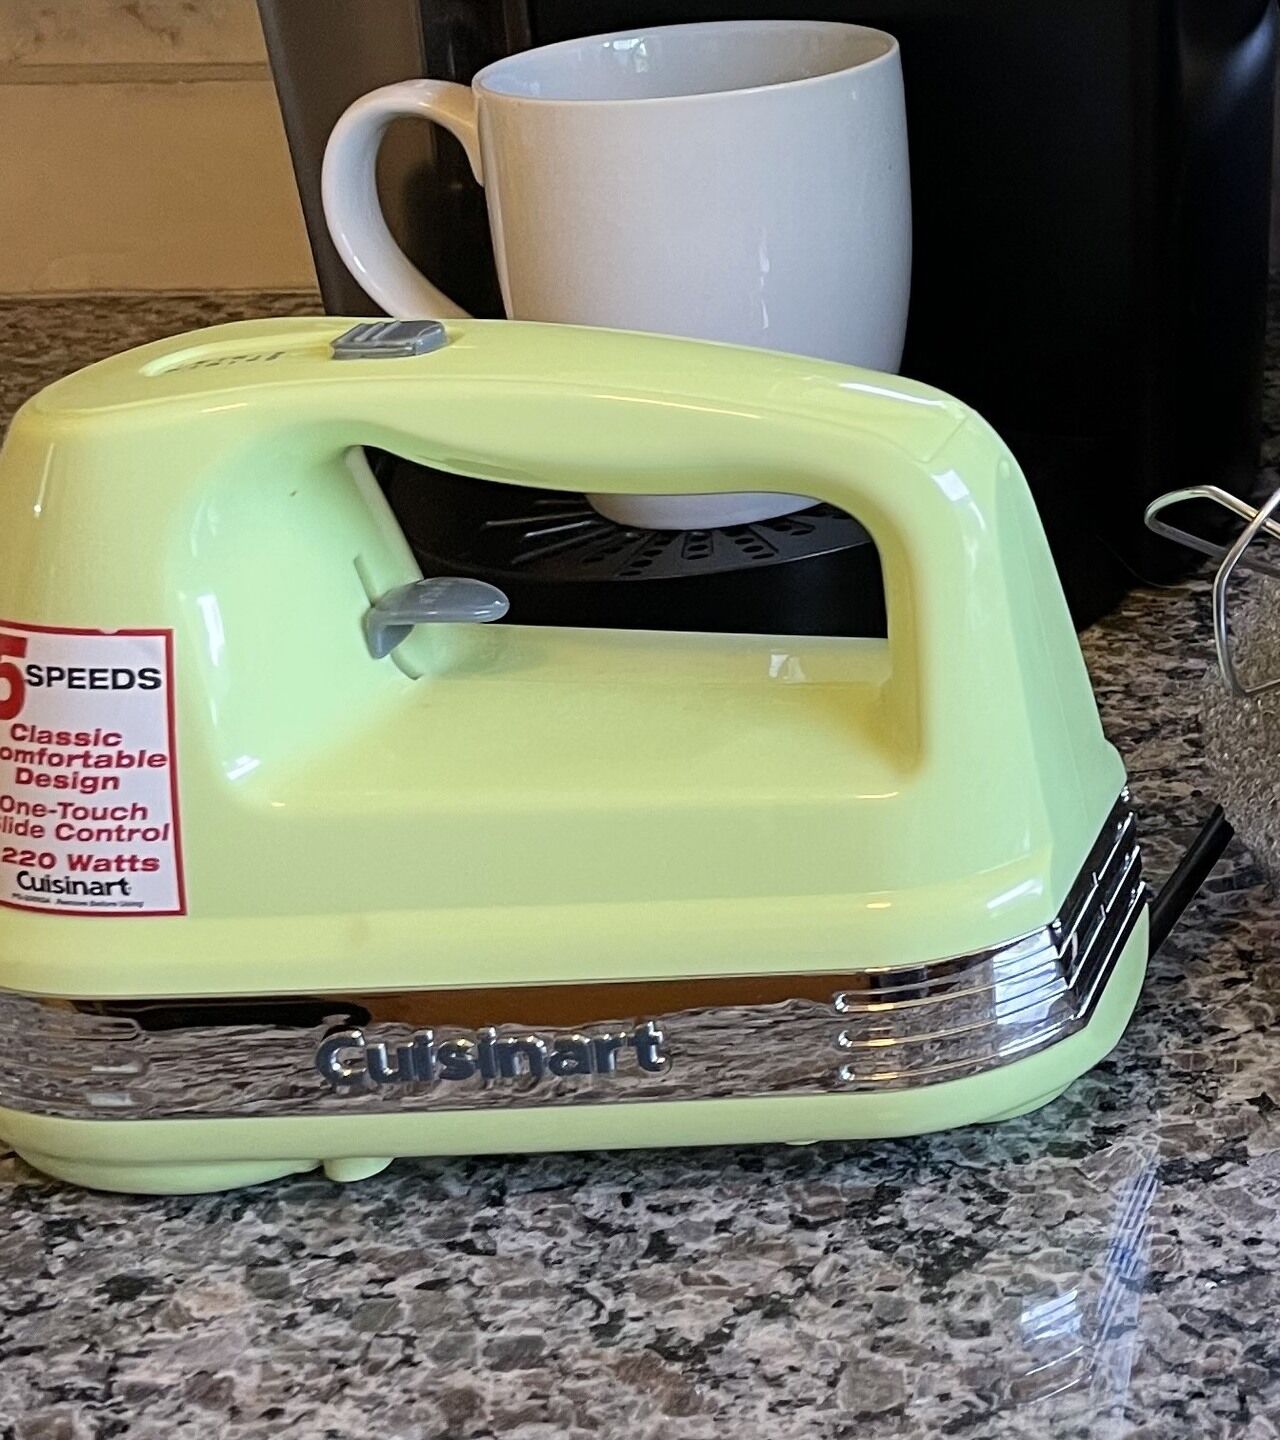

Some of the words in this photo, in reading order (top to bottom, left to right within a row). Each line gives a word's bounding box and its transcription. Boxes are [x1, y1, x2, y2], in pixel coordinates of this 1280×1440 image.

[25, 663, 162, 691] SPEEDS
[10, 722, 123, 748] Classic
[0, 746, 169, 770] omfortable
[15, 766, 121, 795] Design
[0, 794, 150, 822] One-Touch
[0, 815, 46, 840] lide
[55, 822, 171, 843] Control
[2, 846, 58, 870] 220
[66, 853, 161, 873] Watts
[16, 870, 131, 896] Cuisinart
[314, 1019, 668, 1088] Cuisinart
